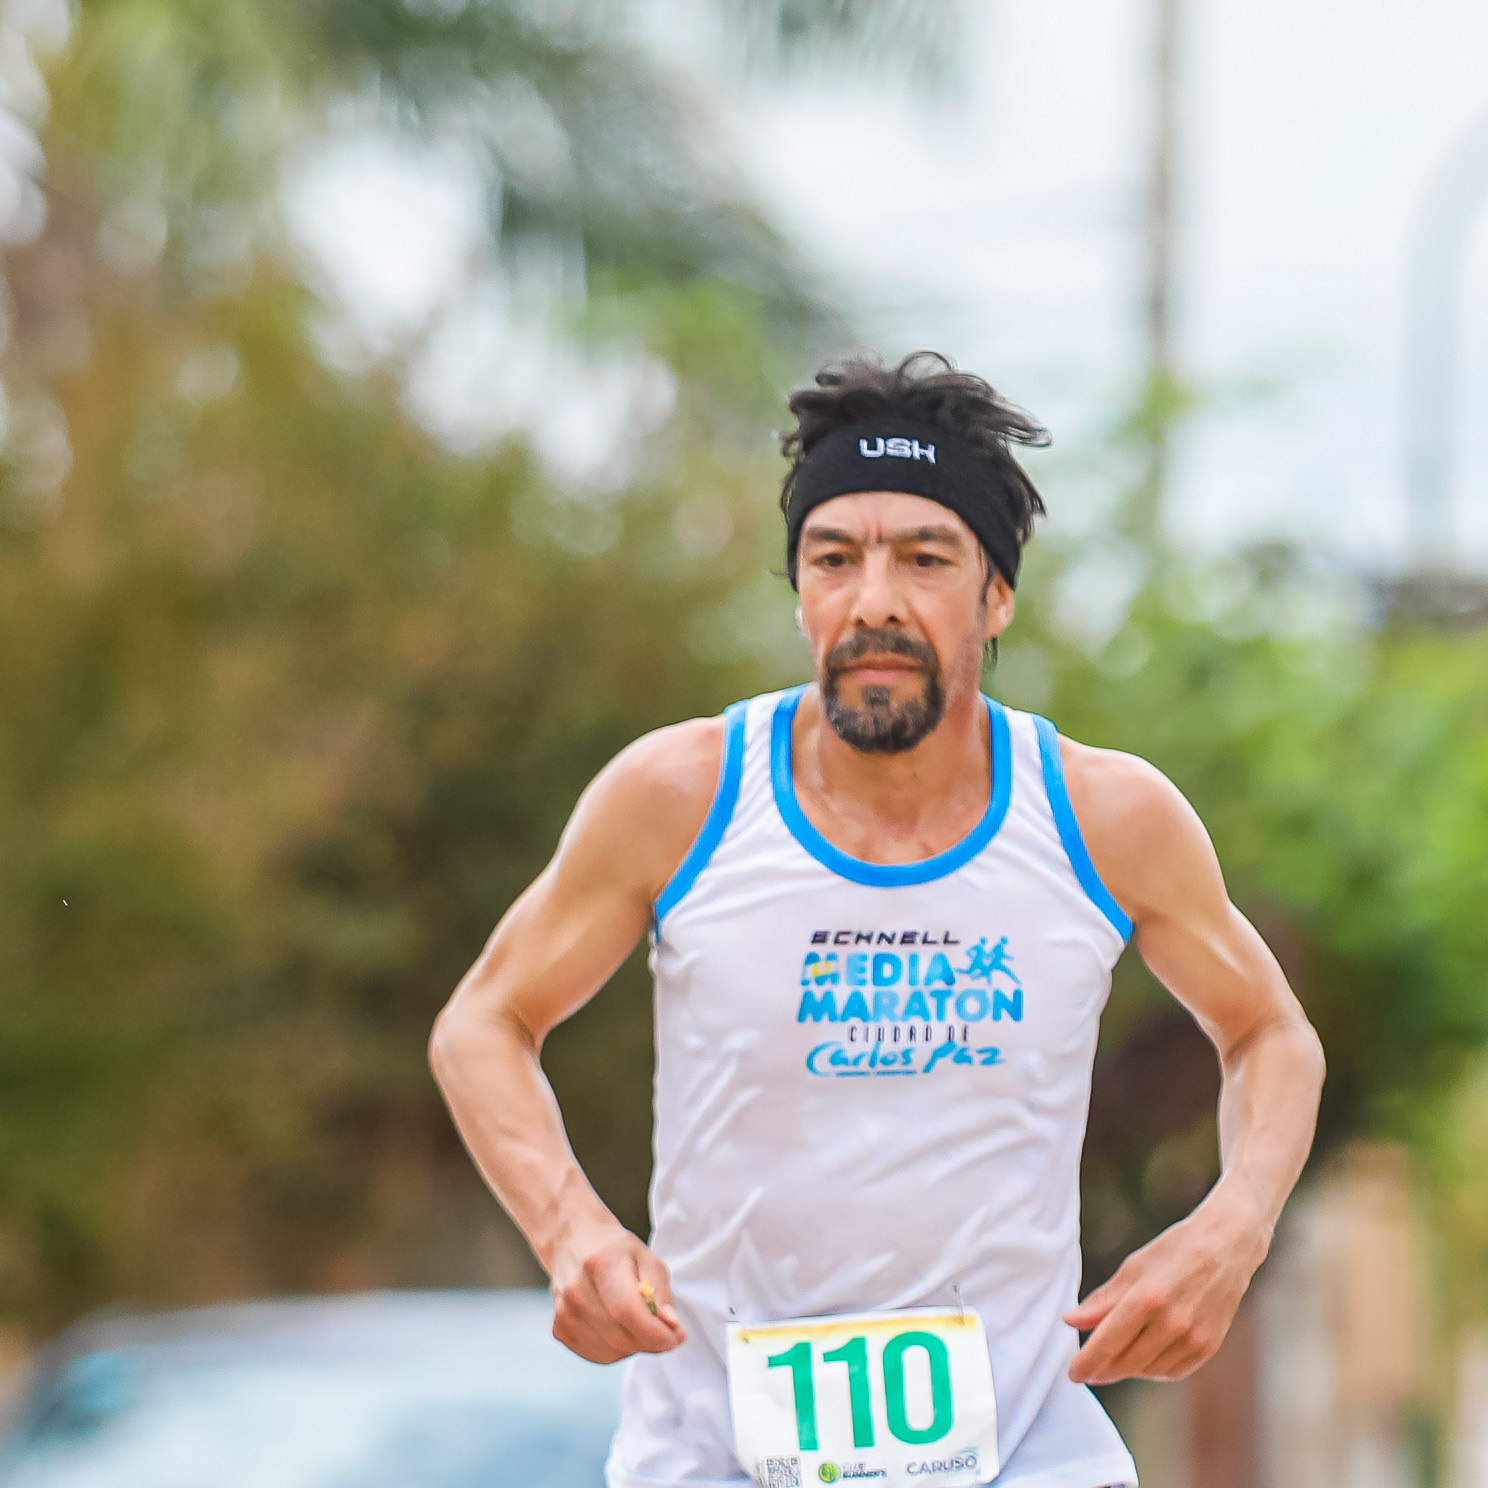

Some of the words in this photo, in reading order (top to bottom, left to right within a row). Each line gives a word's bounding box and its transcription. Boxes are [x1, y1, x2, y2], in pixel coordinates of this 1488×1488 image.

[860, 438, 936, 463] USH
[811, 931, 960, 946] SCHNELL
[800, 952, 956, 986] MEDIA
[850, 1025, 932, 1043] CIUDAD
[948, 1025, 970, 1043] DE
[806, 1041, 917, 1076] Carlos
[767, 1331, 953, 1451] 110
